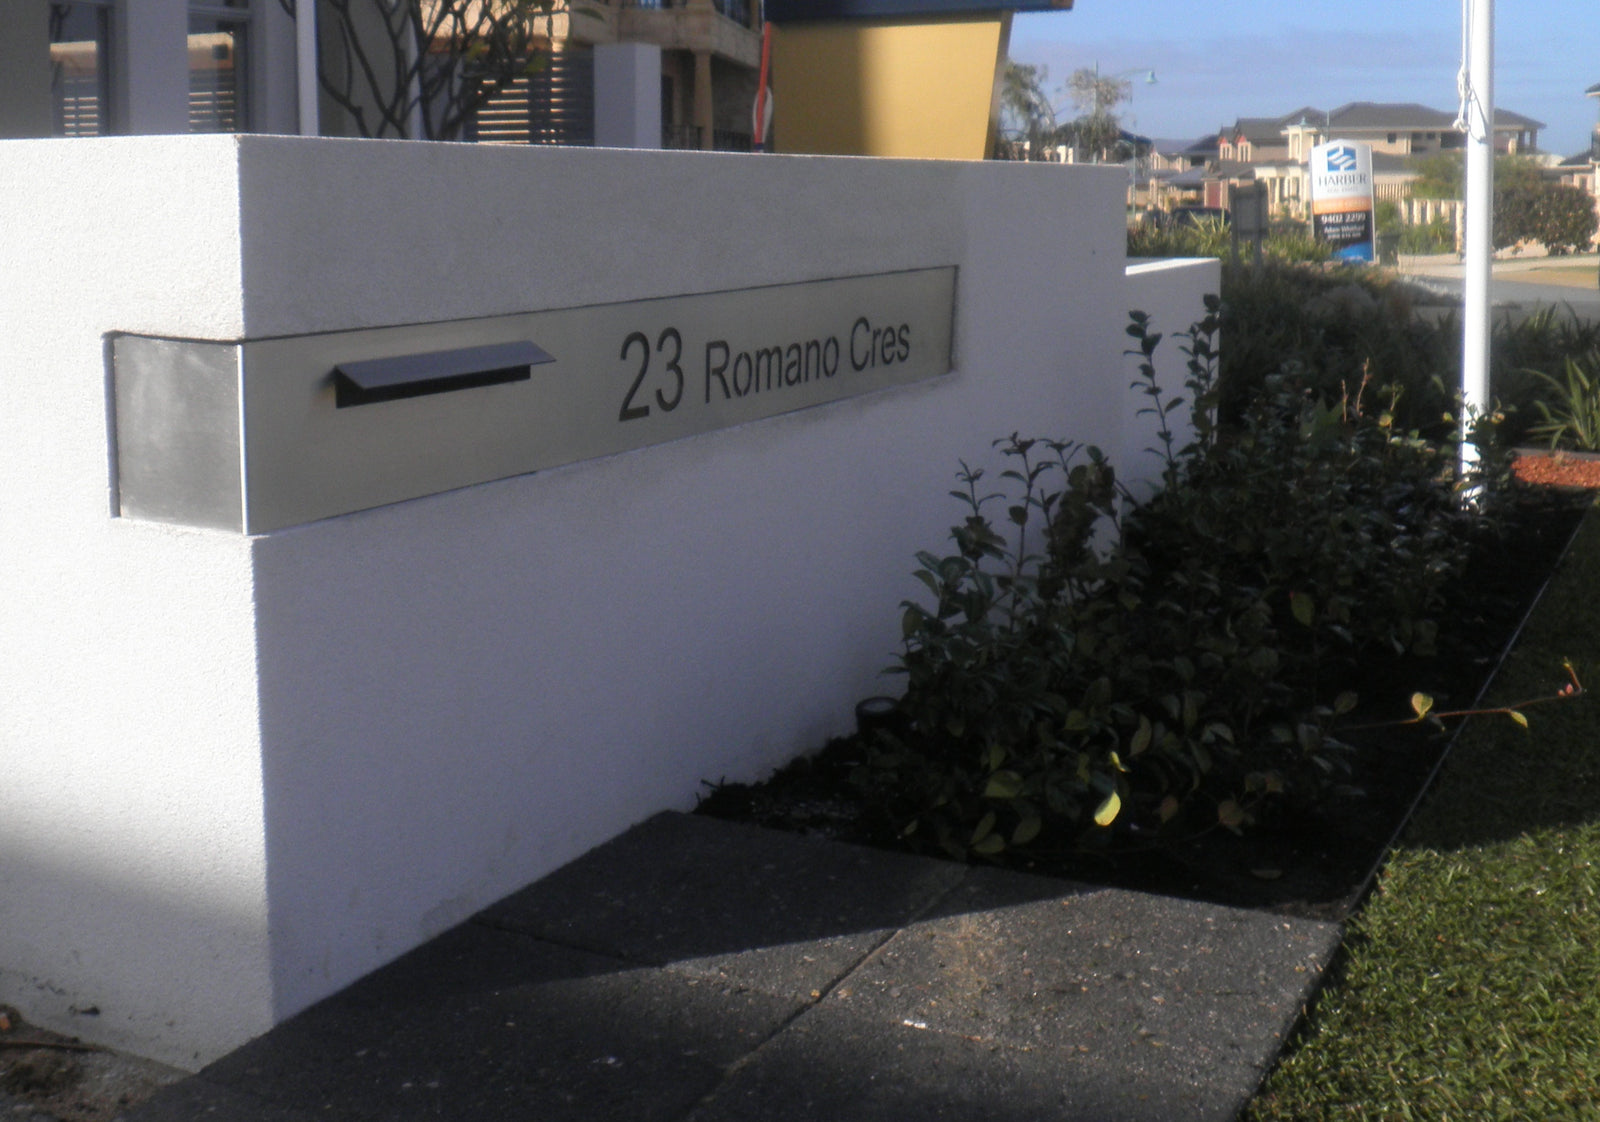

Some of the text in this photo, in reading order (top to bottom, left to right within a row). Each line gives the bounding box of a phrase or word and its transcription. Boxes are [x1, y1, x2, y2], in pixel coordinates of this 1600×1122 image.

[1318, 173, 1367, 187] HARBER
[619, 316, 910, 422] 23 Romano Cres
